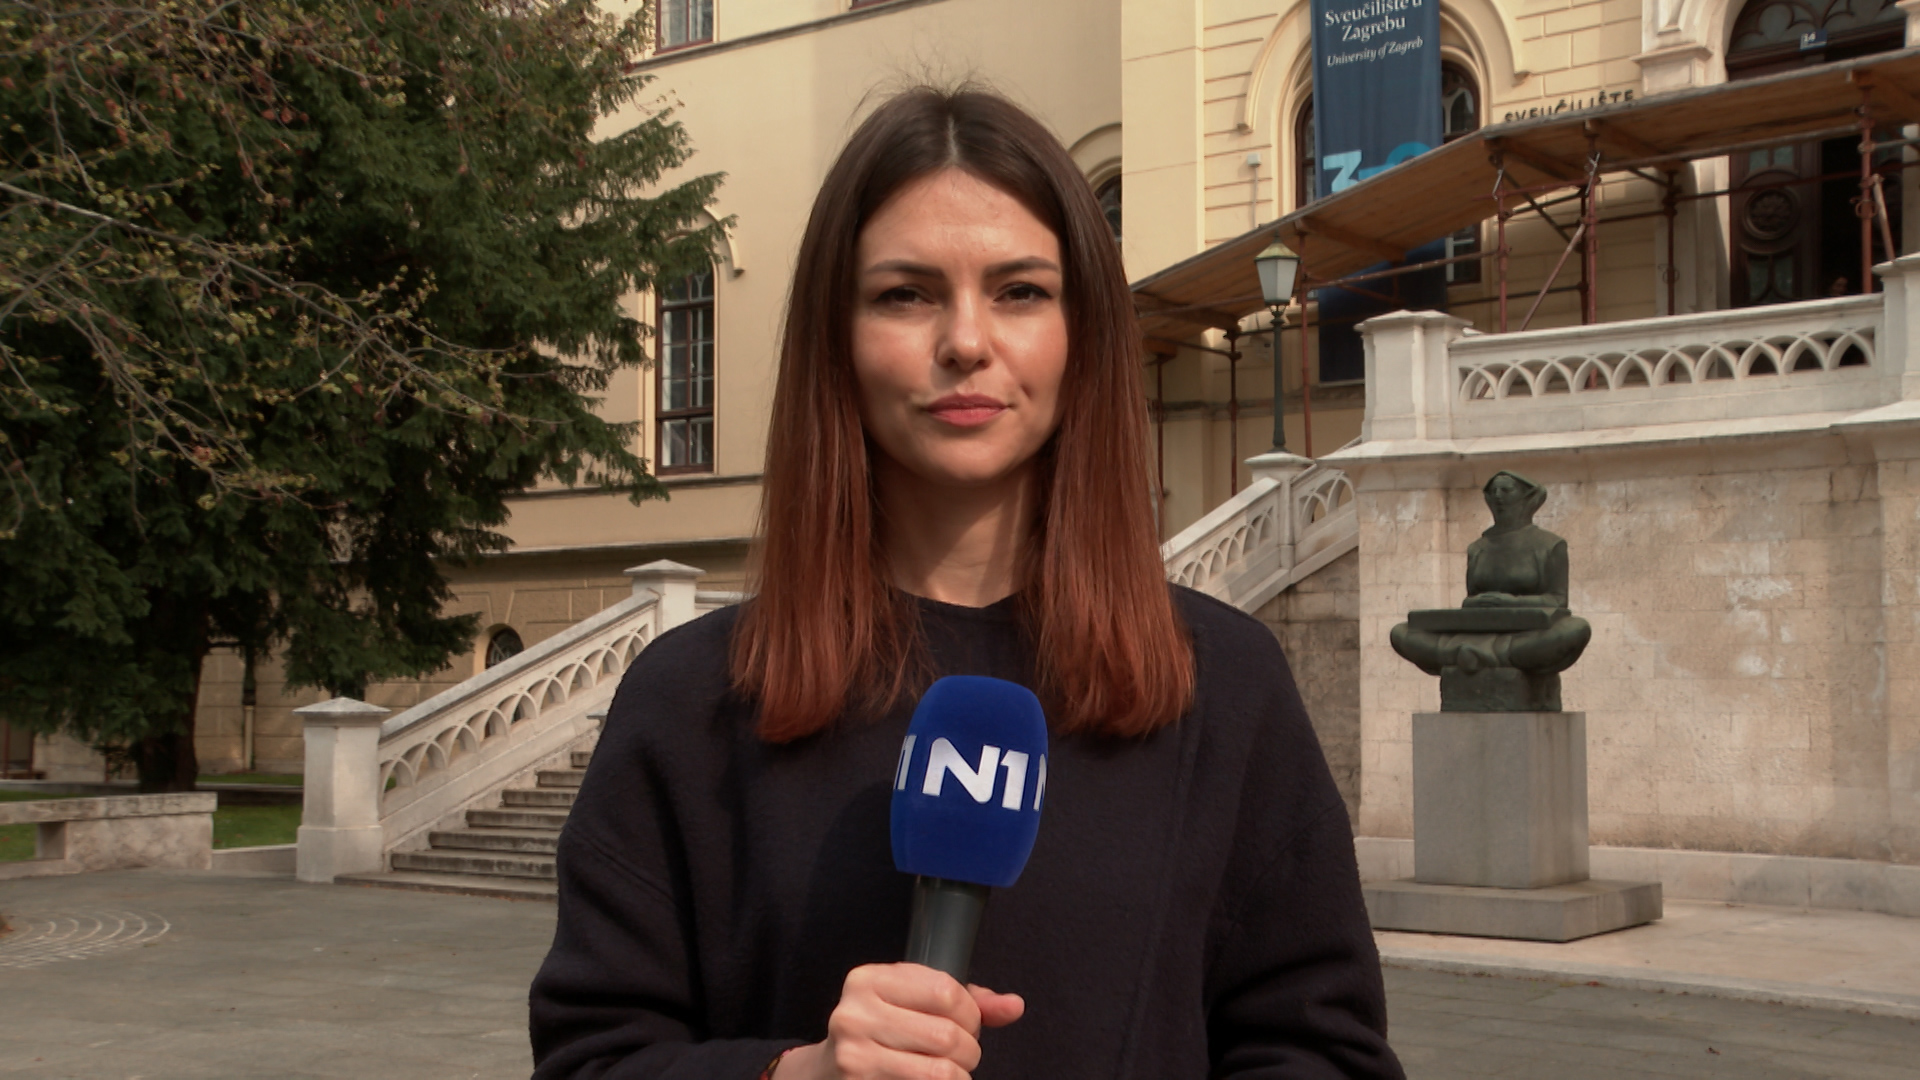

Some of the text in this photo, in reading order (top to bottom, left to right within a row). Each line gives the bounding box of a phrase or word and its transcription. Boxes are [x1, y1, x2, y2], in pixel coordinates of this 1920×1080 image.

[1341, 15, 1406, 42] Zagrebu
[1327, 35, 1424, 67] University of Zagreb
[922, 737, 1029, 812] N1
